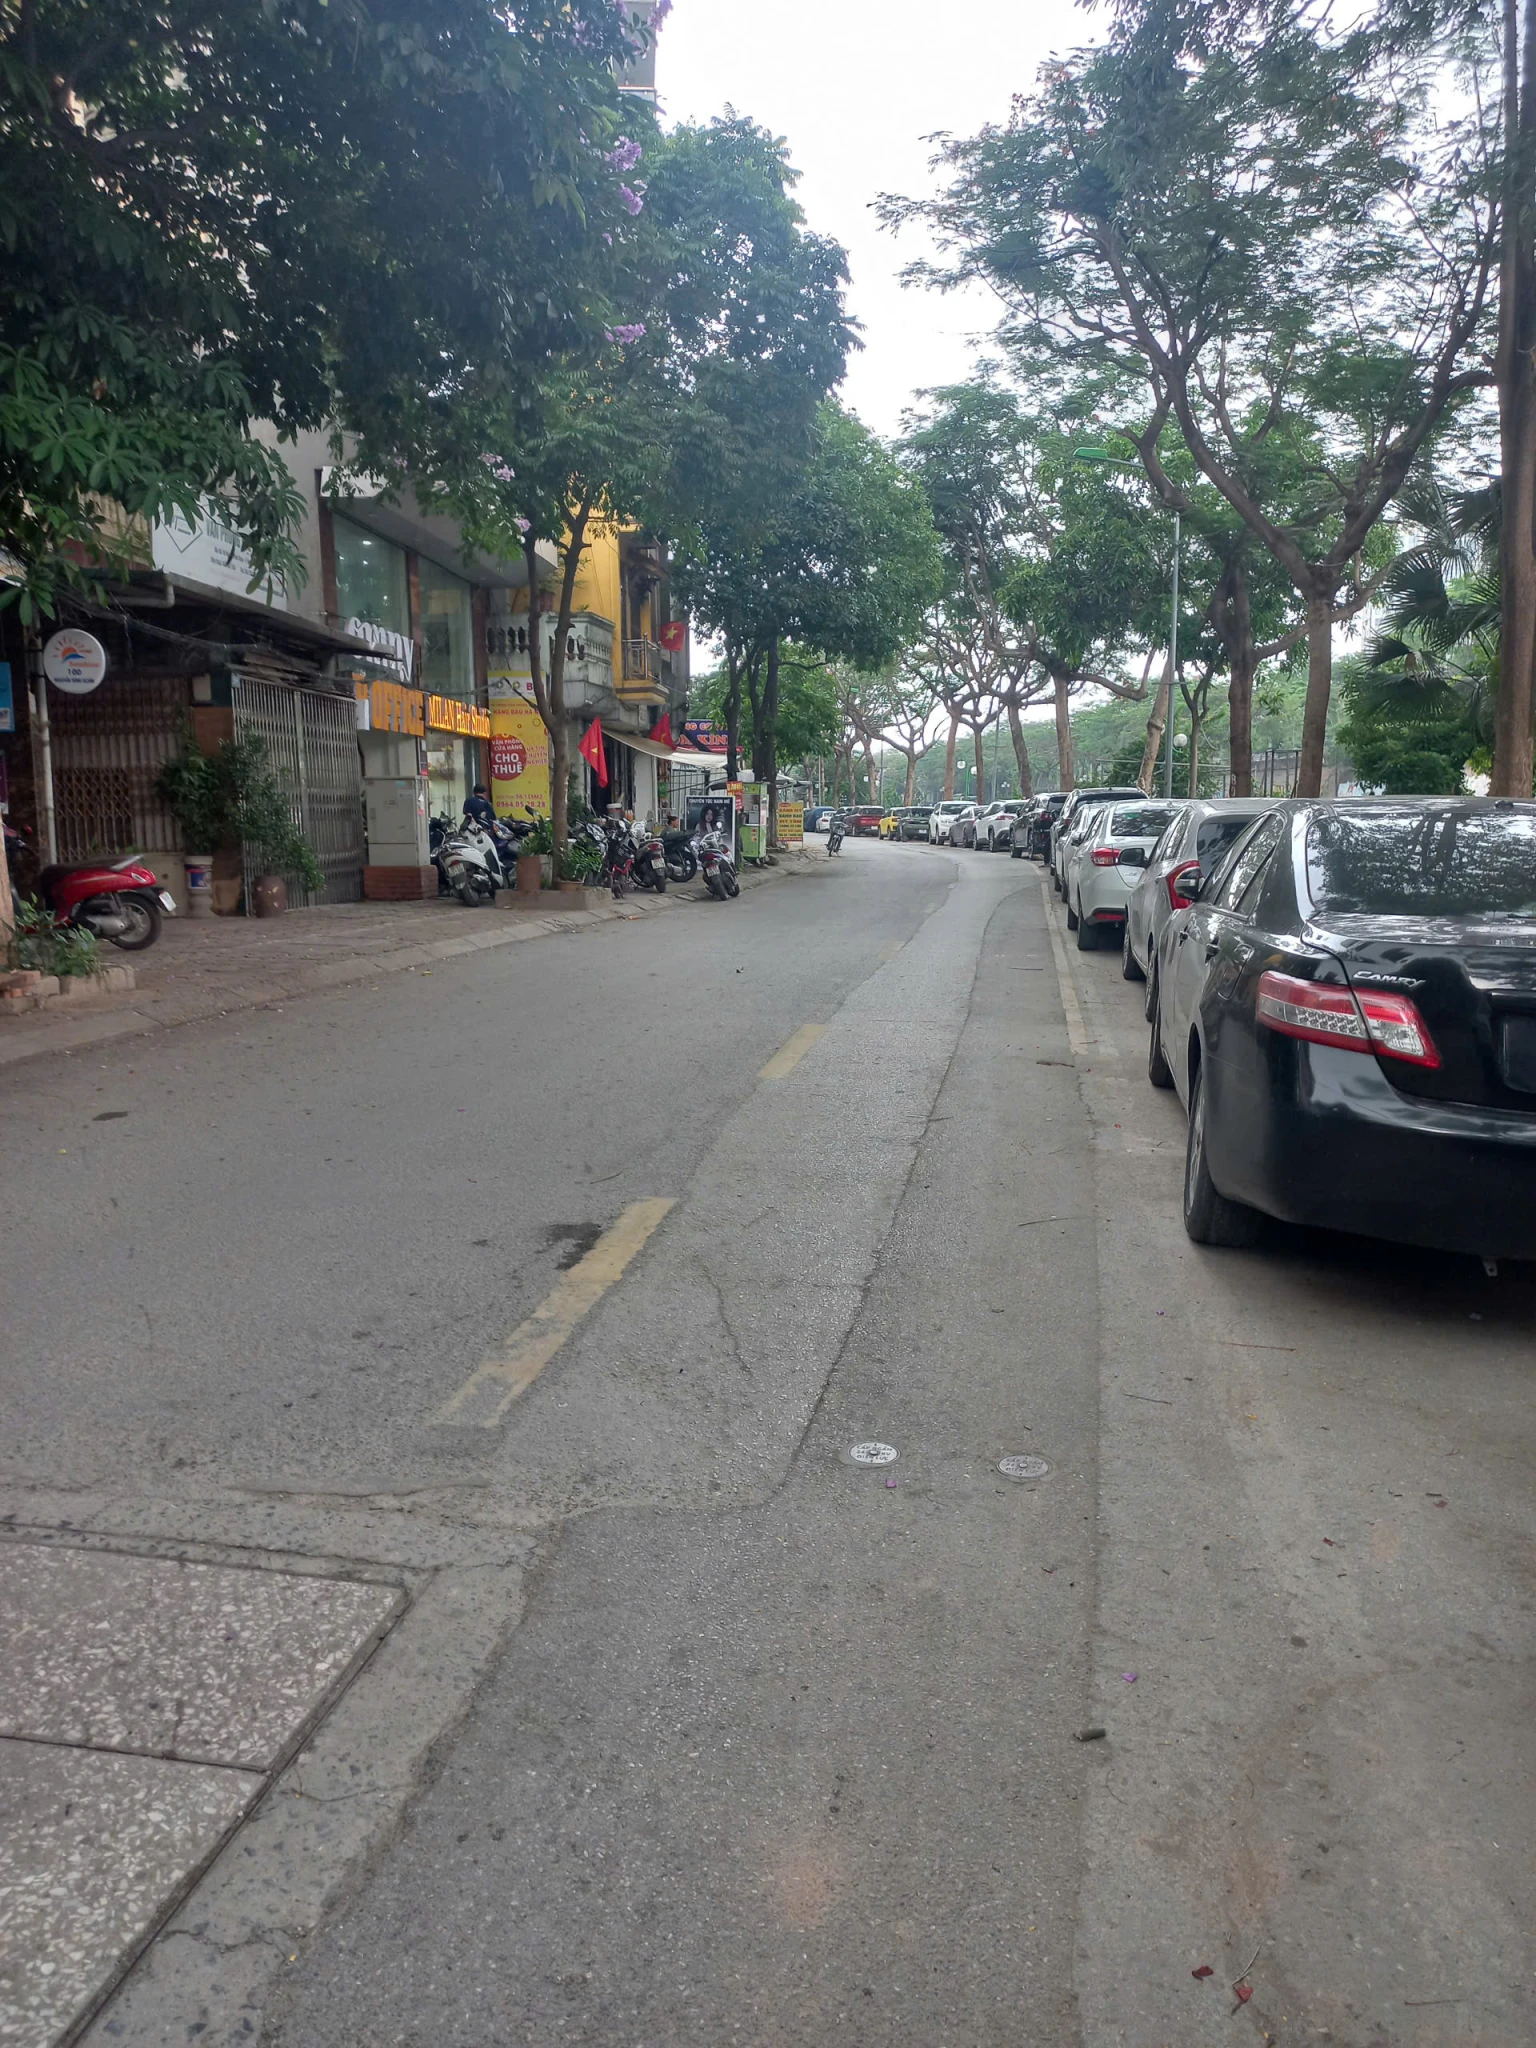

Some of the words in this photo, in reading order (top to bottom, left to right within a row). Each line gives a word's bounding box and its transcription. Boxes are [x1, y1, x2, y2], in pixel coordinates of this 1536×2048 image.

[428, 694, 455, 731] MILAN
[455, 700, 471, 734] Hair
[495, 753, 519, 763] CHO
[493, 762, 523, 774] THUÊ
[1353, 970, 1426, 988] CAMRY
